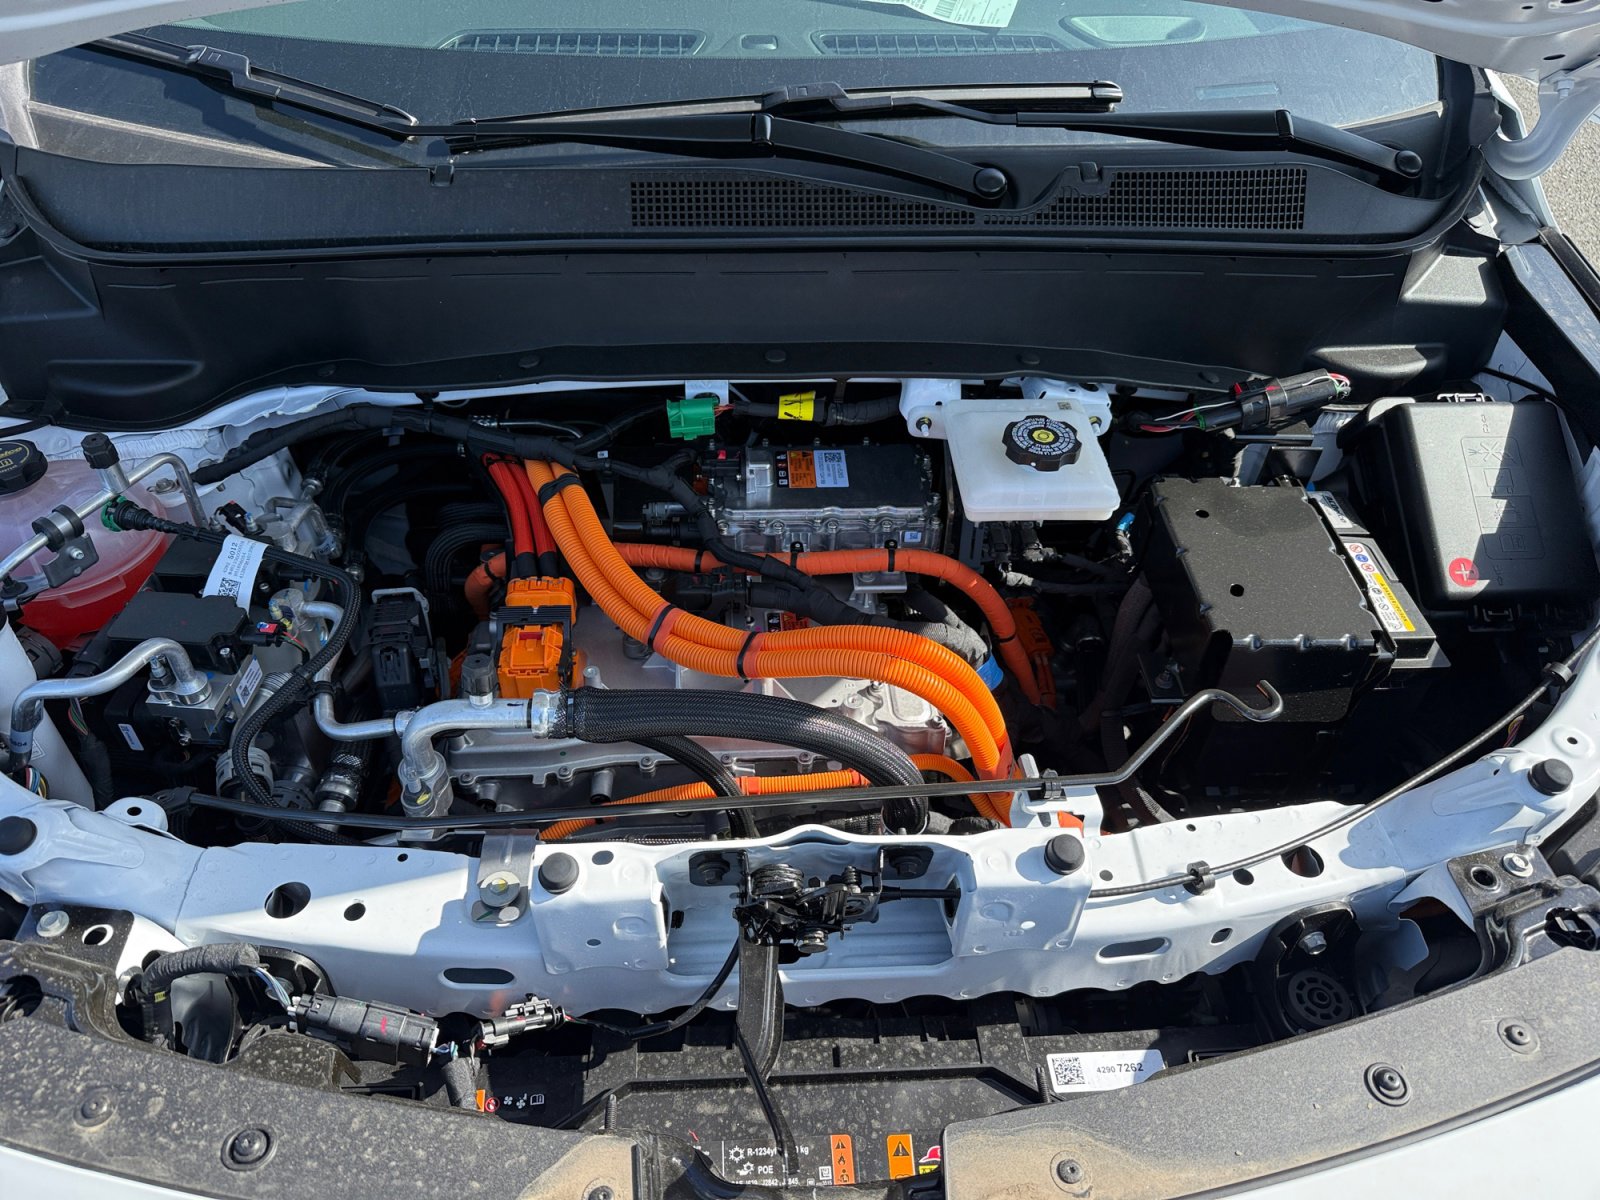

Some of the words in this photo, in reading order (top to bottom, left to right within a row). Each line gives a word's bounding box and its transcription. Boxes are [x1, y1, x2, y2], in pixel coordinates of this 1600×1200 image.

[228, 542, 239, 560] 5012
[1116, 1062, 1144, 1072] 7262
[800, 1145, 809, 1155] kg
[757, 1165, 774, 1175] POE
